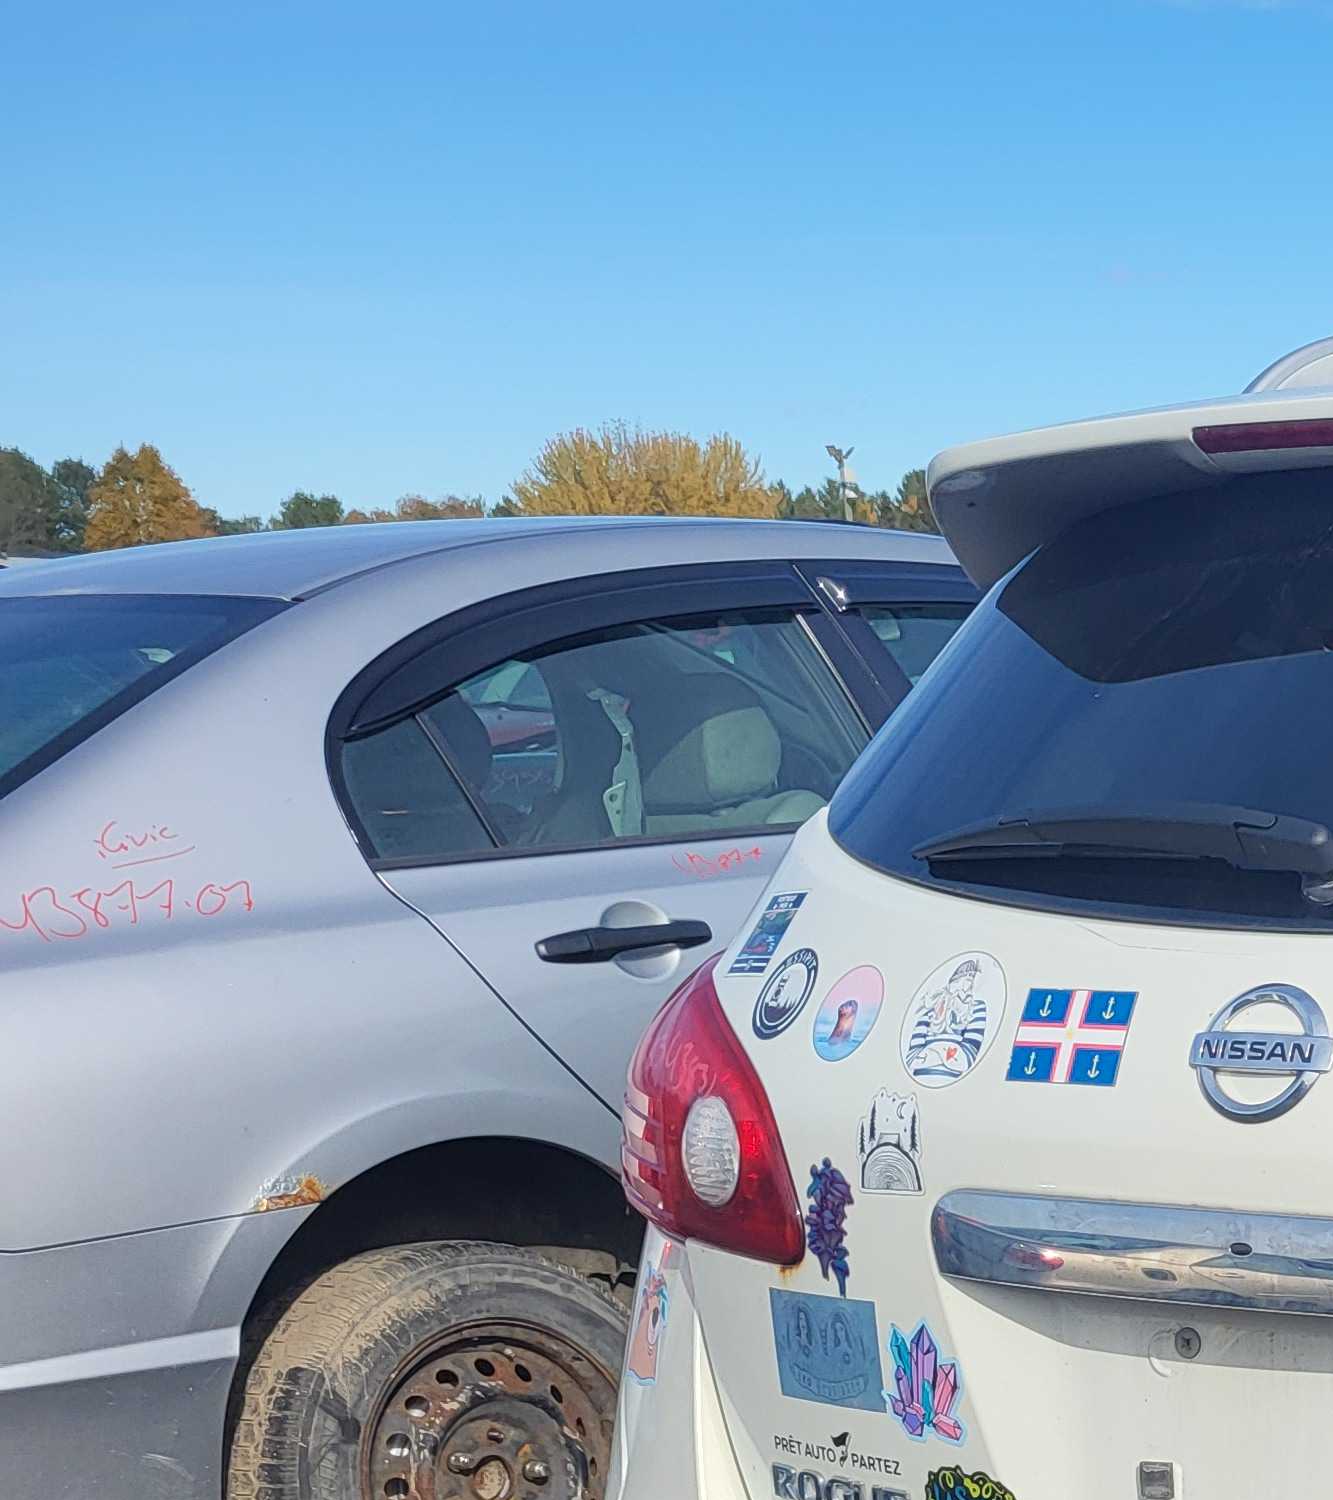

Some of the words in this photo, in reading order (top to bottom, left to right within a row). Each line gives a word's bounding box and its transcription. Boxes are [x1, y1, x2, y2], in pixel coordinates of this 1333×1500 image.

[1199, 1037, 1316, 1065] NISSAN
[774, 1433, 802, 1456] PRÊT
[804, 1443, 837, 1464] AUTO
[850, 1452, 902, 1476] PARTEZ
